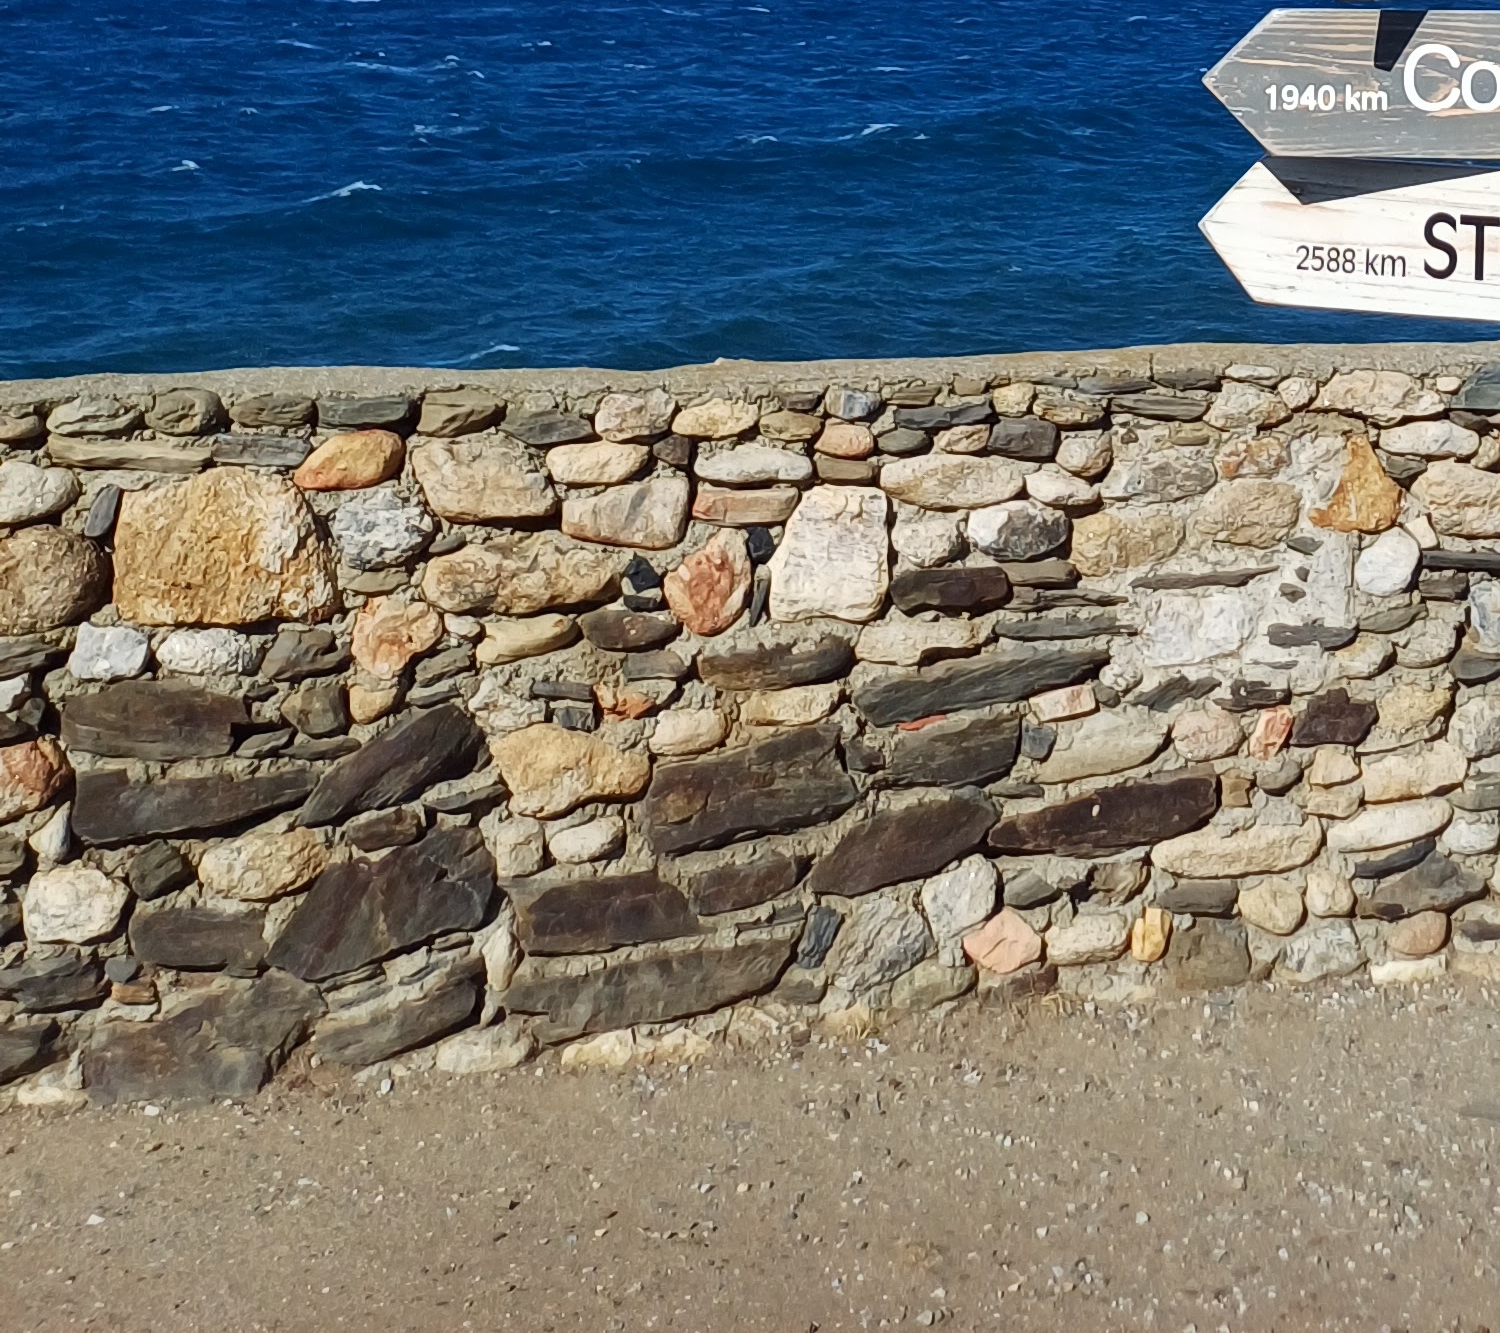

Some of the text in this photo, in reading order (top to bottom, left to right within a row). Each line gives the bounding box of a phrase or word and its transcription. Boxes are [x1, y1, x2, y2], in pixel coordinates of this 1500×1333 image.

[1264, 84, 1337, 113] 1940
[1344, 84, 1389, 113] km
[1295, 244, 1357, 275] 2588
[1364, 247, 1407, 279] km
